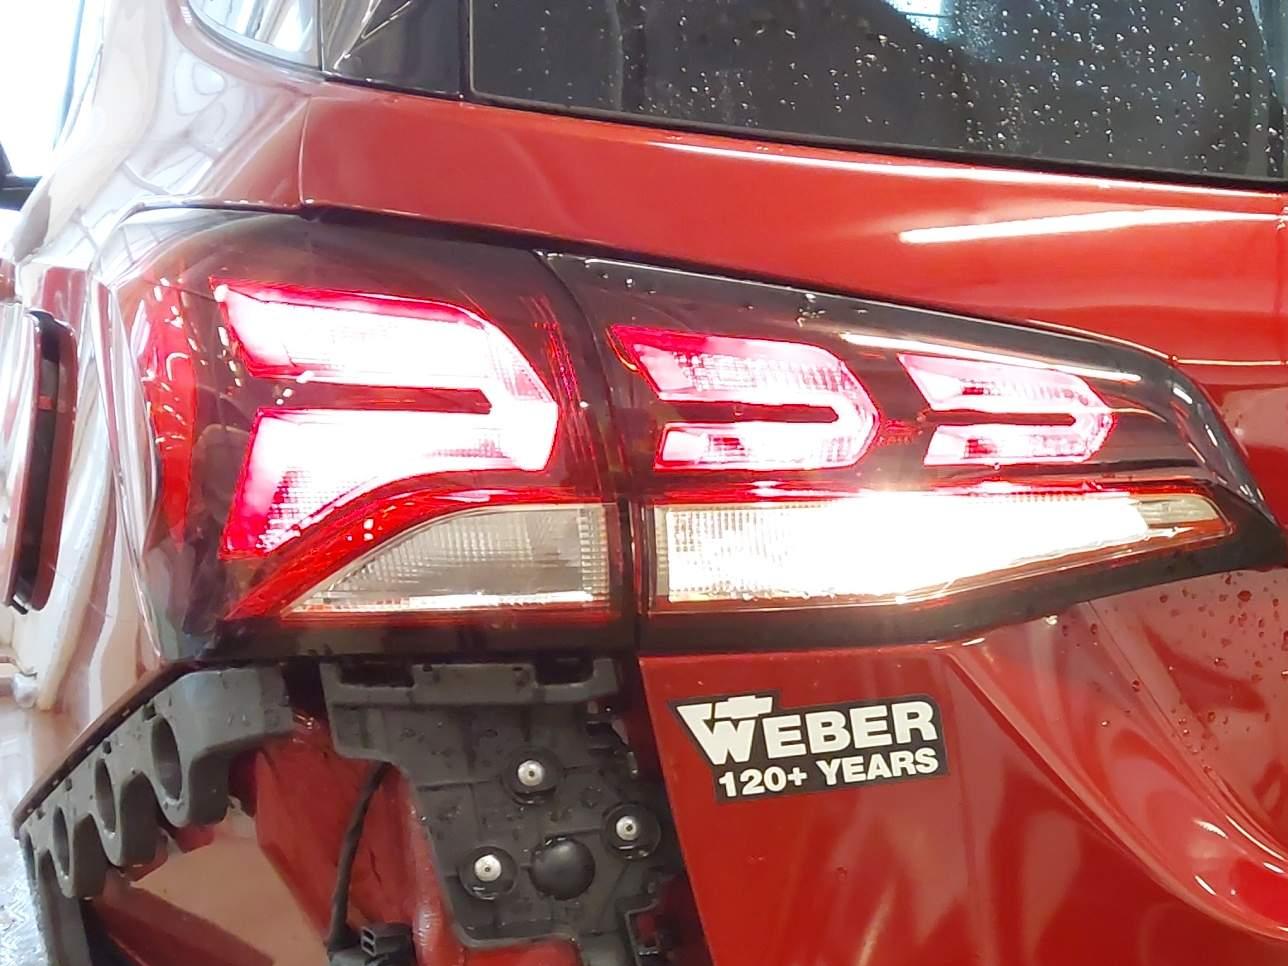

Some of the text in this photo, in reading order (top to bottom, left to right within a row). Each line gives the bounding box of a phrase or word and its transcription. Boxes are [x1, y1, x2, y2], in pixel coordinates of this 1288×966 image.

[676, 699, 938, 765] WEBER
[719, 748, 939, 797] 120+ YEARS
